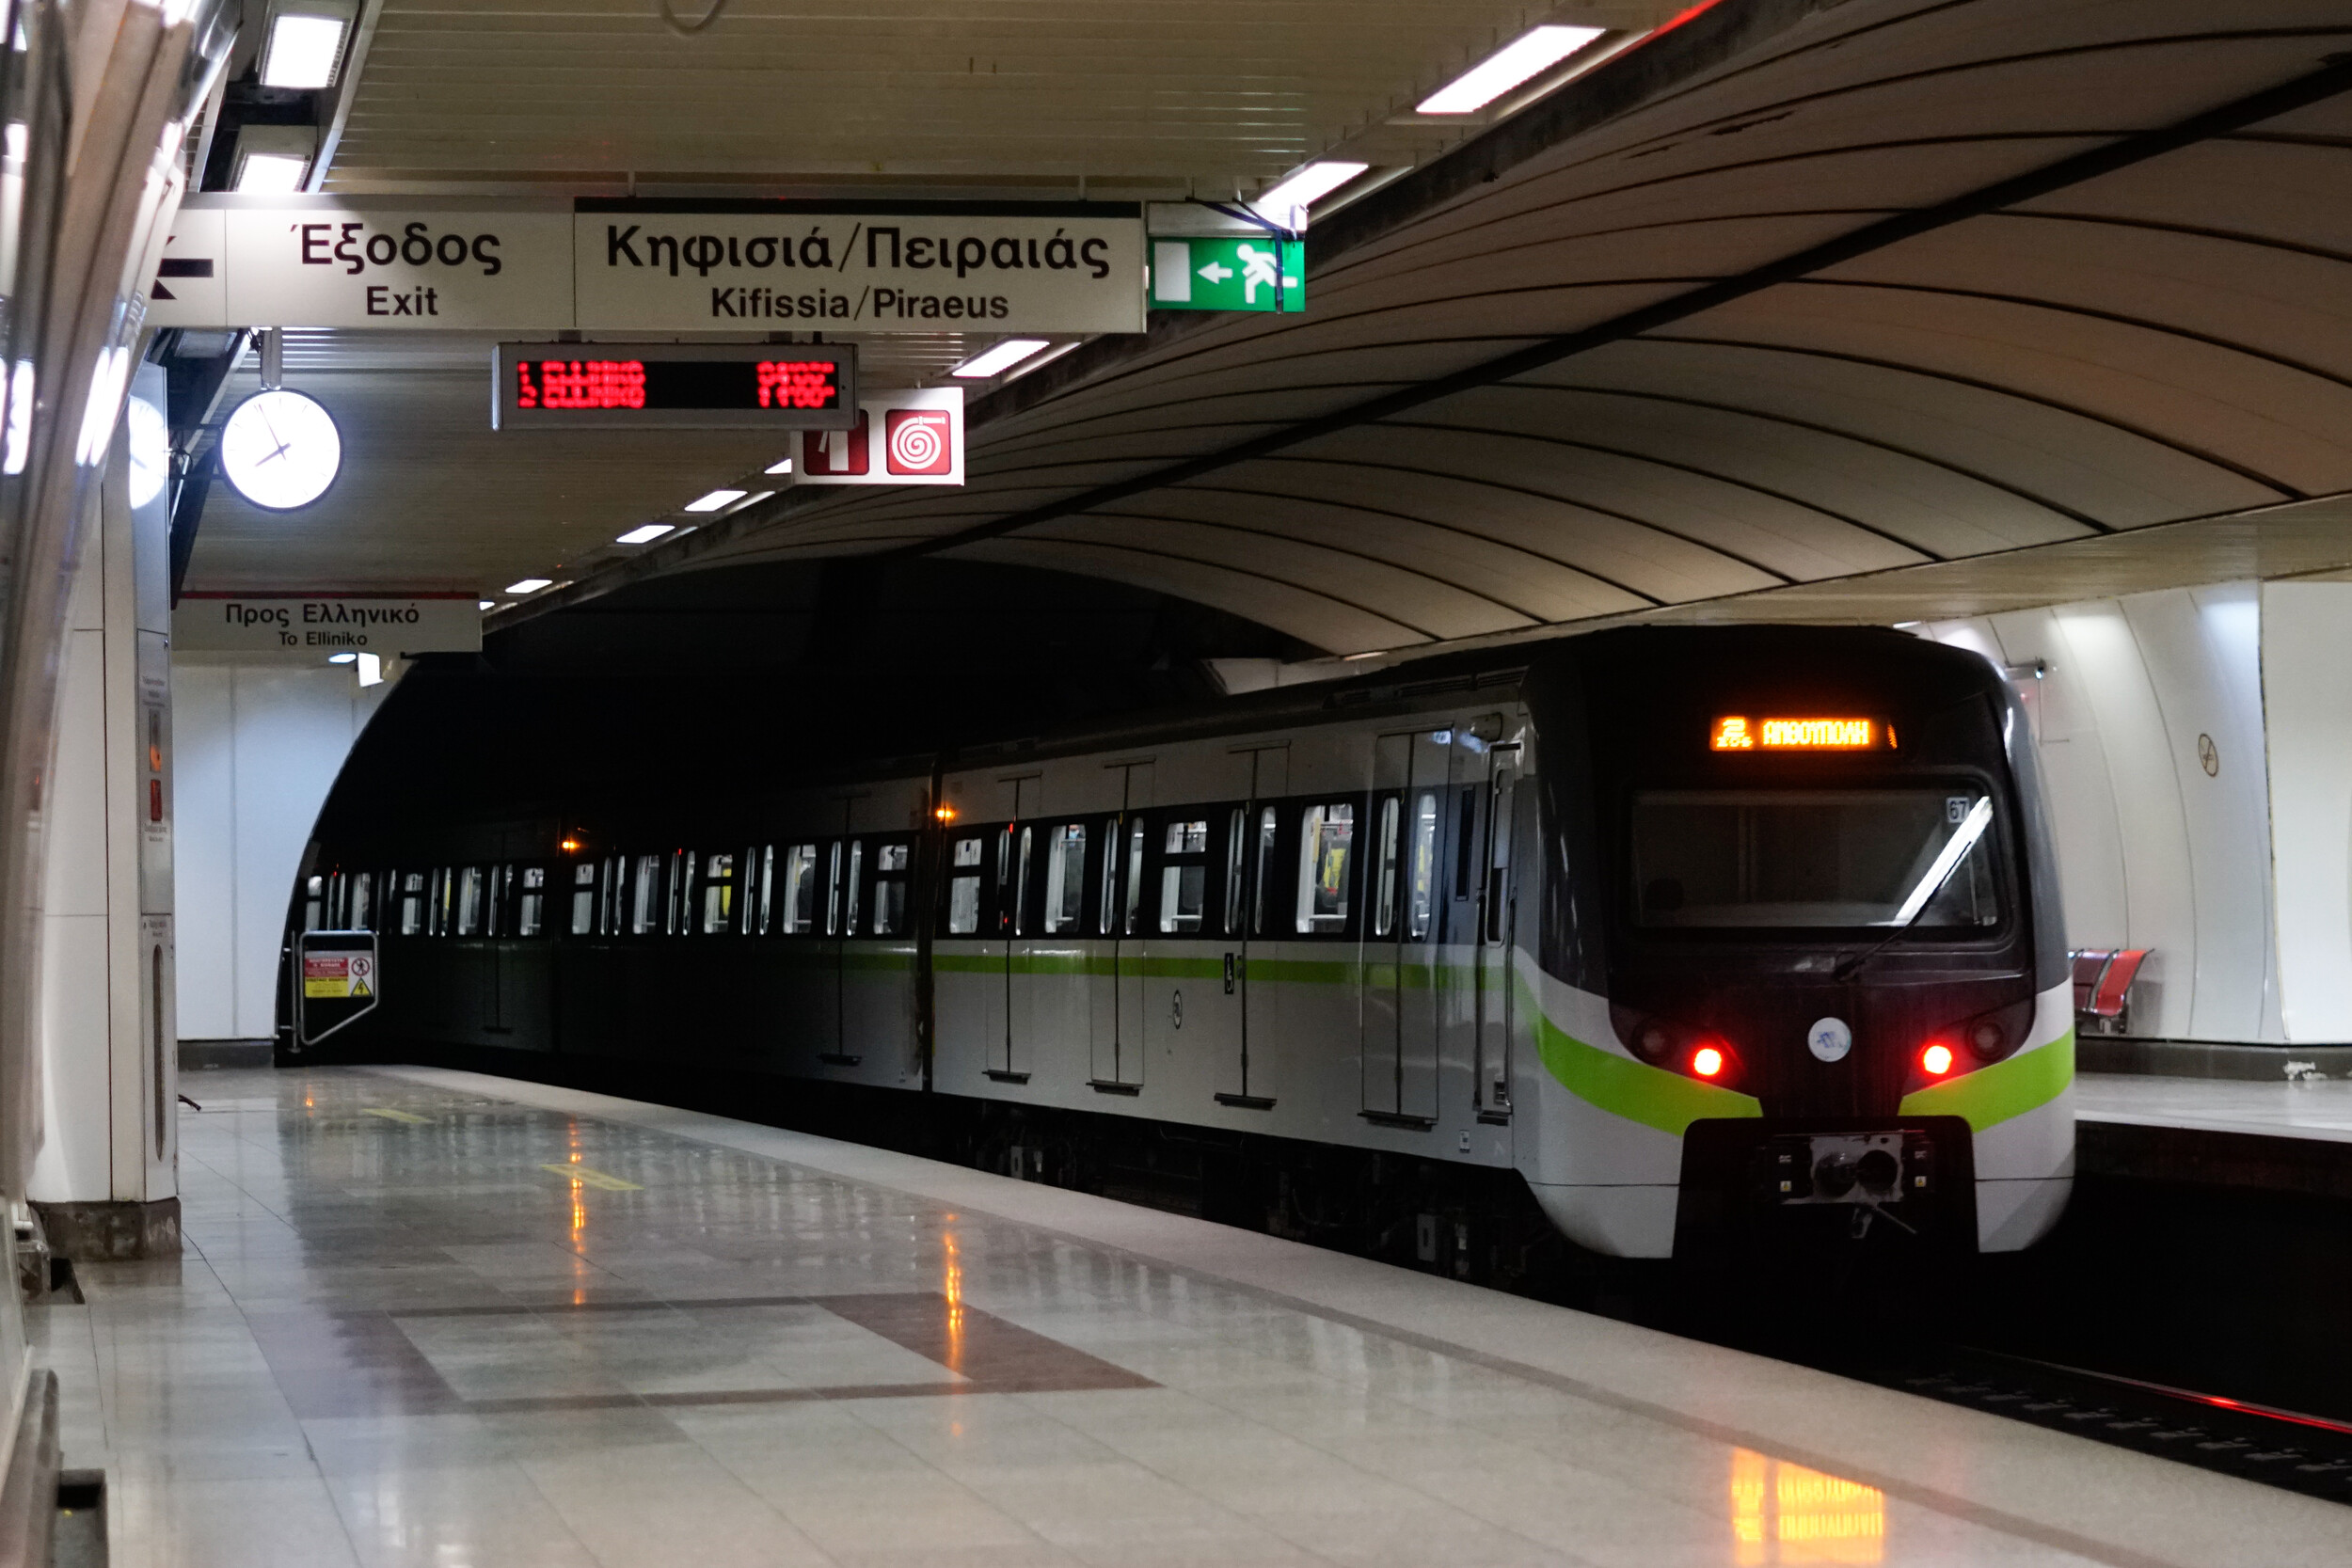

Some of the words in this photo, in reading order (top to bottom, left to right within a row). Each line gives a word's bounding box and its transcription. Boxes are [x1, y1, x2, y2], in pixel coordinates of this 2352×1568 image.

[290, 222, 501, 276] Έξοδος
[607, 223, 1110, 278] Κηφισιά/Πειραιάς
[367, 286, 438, 316] Exit
[711, 285, 1009, 321] Kifissia/Piraeus
[226, 604, 290, 627] Προς
[303, 603, 421, 628] Ελληνικό
[278, 631, 298, 646] To
[306, 631, 368, 646] Elliniko
[1949, 800, 1967, 820] 67
